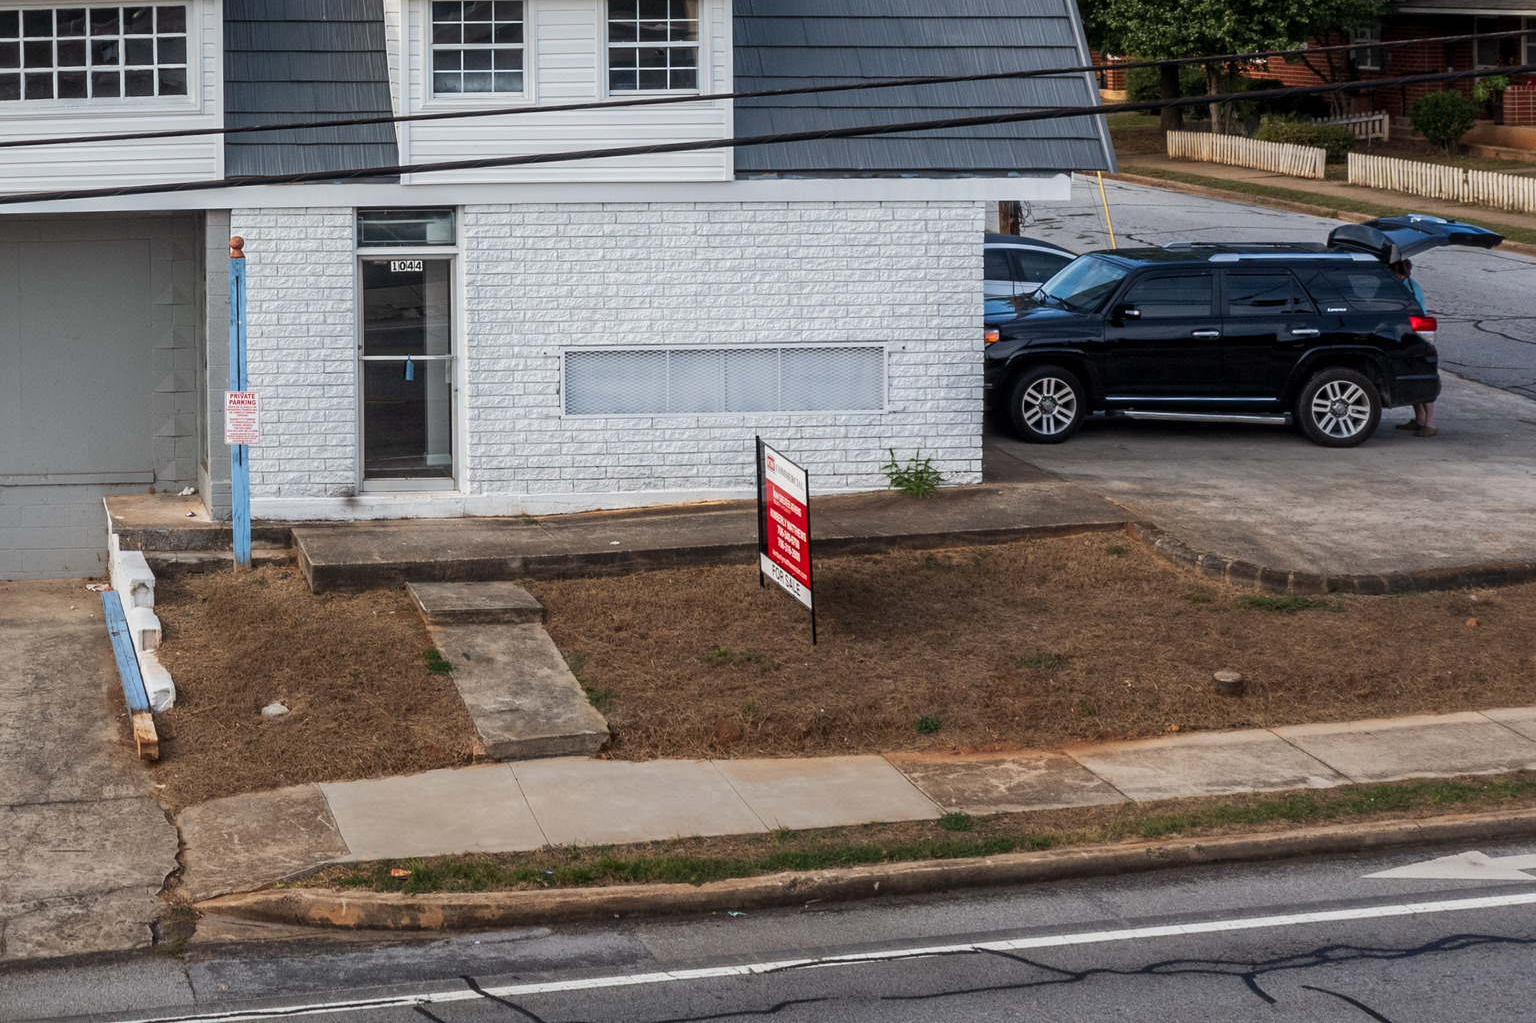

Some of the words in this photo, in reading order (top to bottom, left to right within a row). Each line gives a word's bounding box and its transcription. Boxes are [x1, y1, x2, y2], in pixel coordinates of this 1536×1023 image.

[392, 261, 422, 271] 1044
[786, 519, 807, 542] MATTHEWS
[772, 564, 785, 584] FOR
[785, 574, 801, 597] SALE
